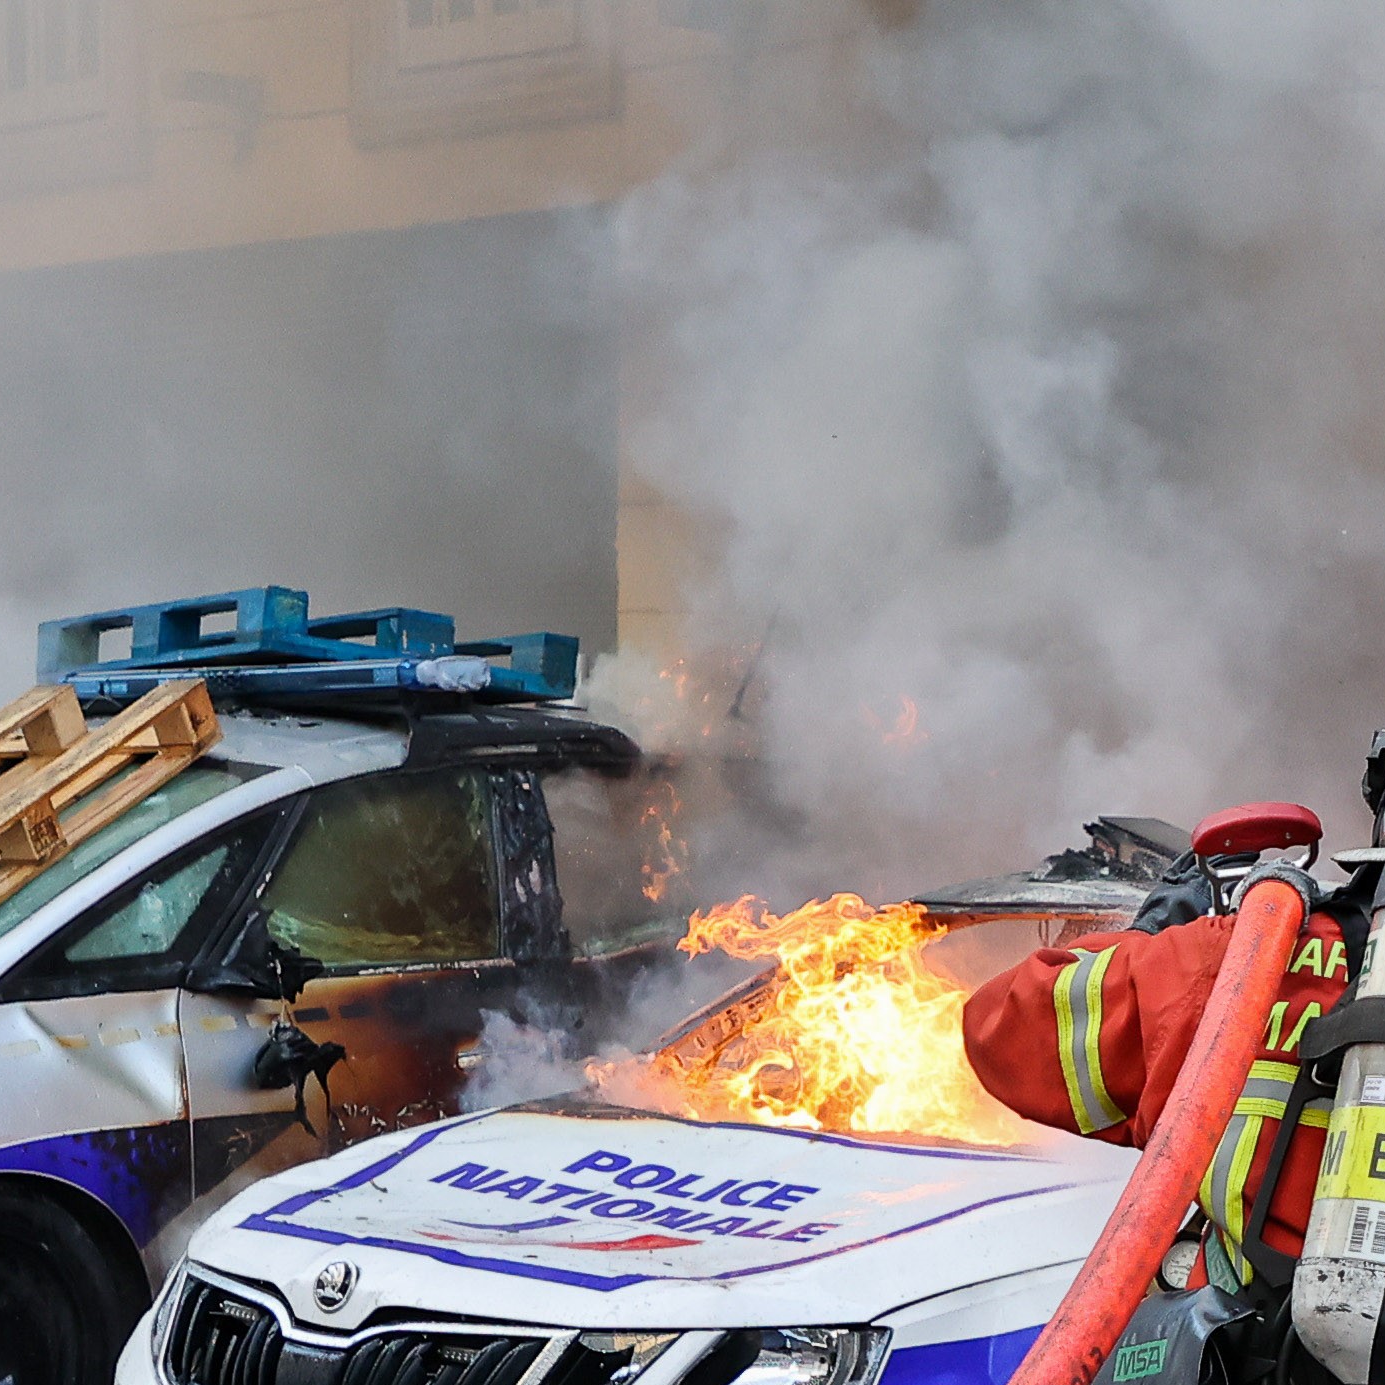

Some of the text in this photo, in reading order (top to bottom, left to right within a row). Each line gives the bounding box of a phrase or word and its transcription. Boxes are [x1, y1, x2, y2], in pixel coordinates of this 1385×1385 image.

[428, 1161, 843, 1243] NATIONALE
[561, 1150, 822, 1212] POLICE
[1116, 1346, 1161, 1377] MSA
